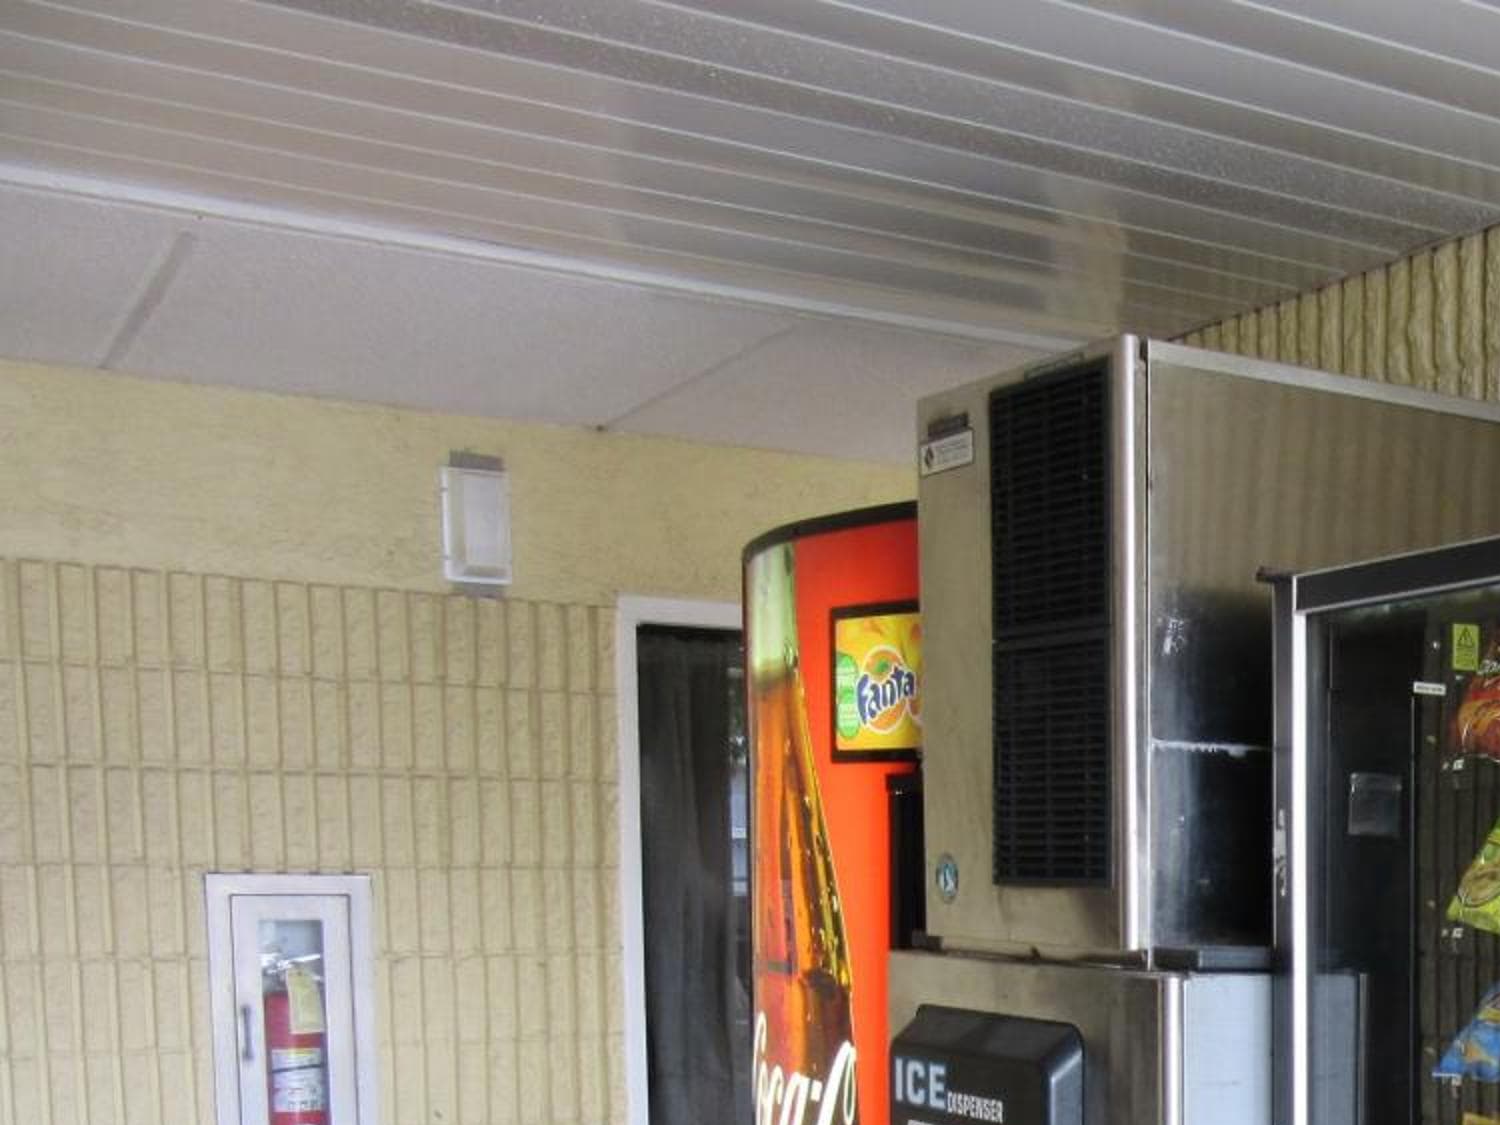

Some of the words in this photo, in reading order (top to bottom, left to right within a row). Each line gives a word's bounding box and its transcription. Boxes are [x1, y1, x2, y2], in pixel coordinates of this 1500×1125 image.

[857, 665, 915, 726] Fanta
[895, 1057, 946, 1110] ICE
[947, 1091, 1003, 1124] DISPENSER
